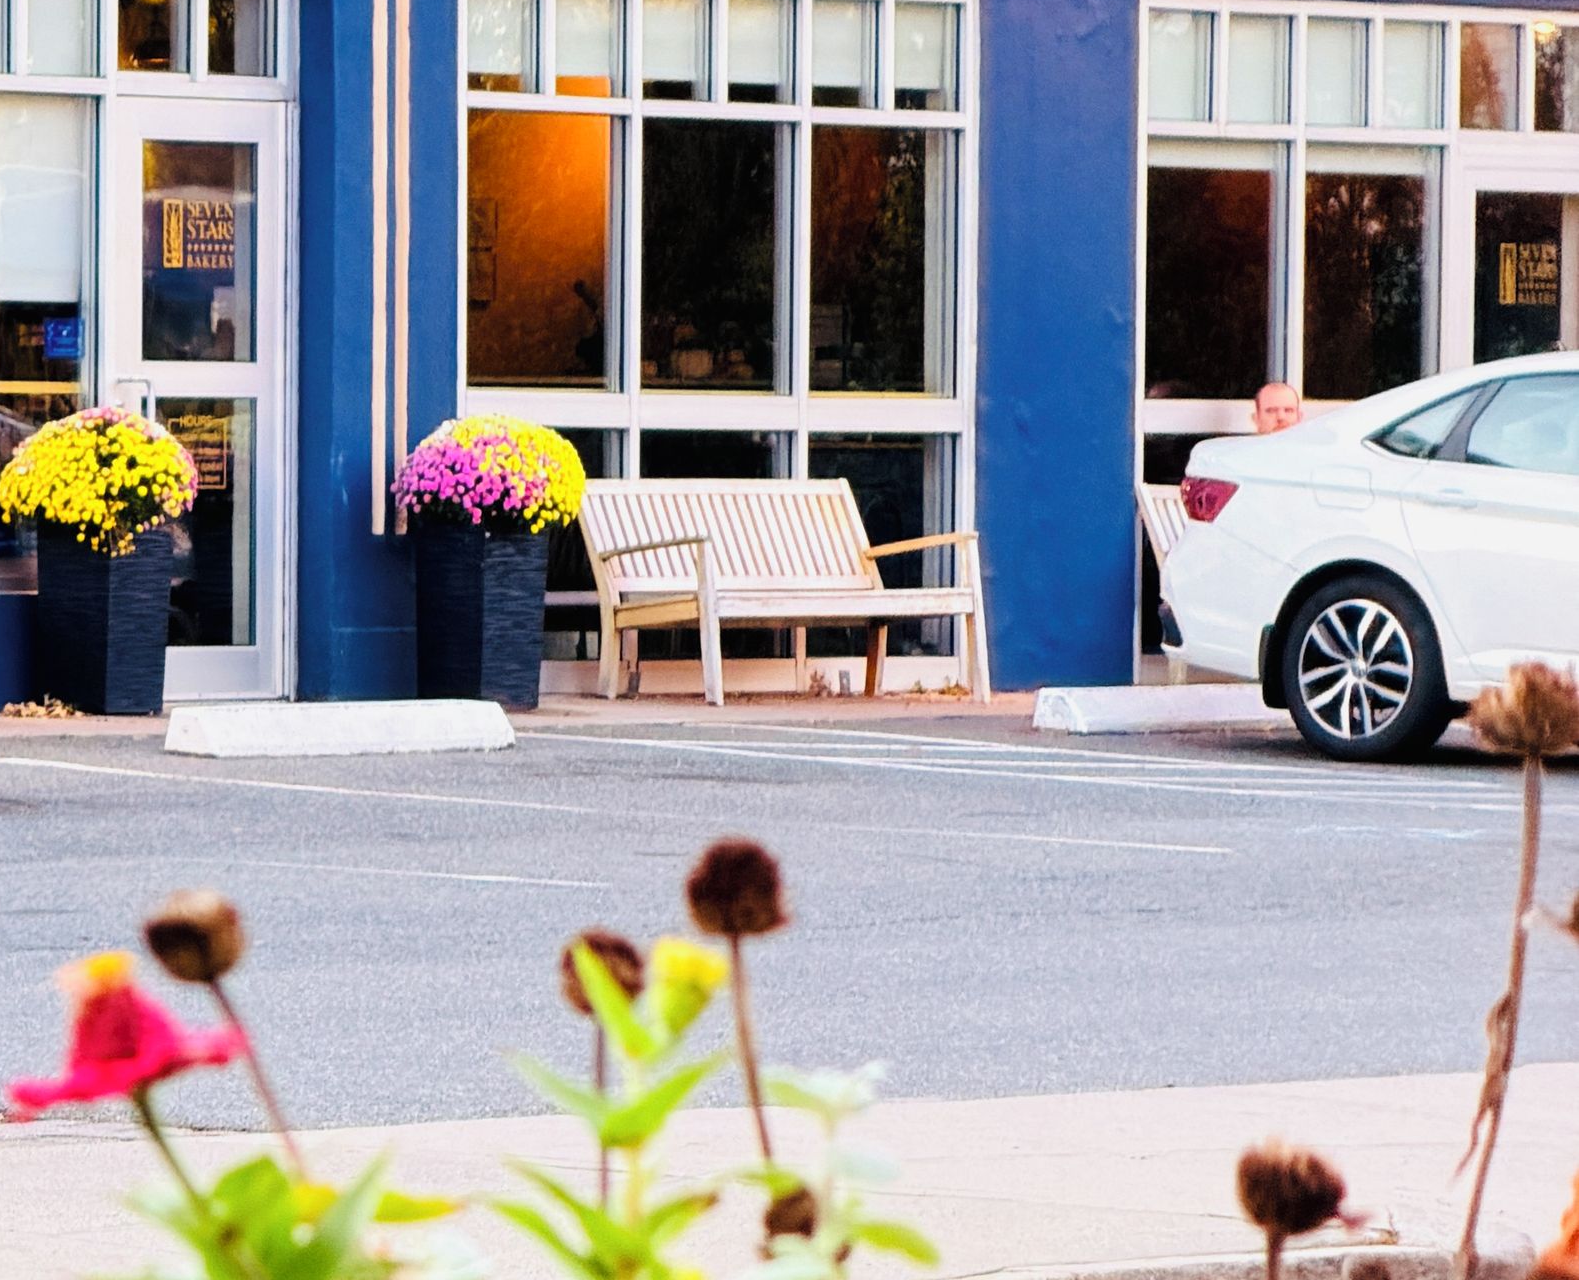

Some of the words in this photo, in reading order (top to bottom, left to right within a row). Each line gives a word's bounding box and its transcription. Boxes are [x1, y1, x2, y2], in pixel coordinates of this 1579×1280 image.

[186, 200, 234, 219] SEVEN
[186, 218, 234, 240] STARS
[186, 253, 234, 269] BAKERY
